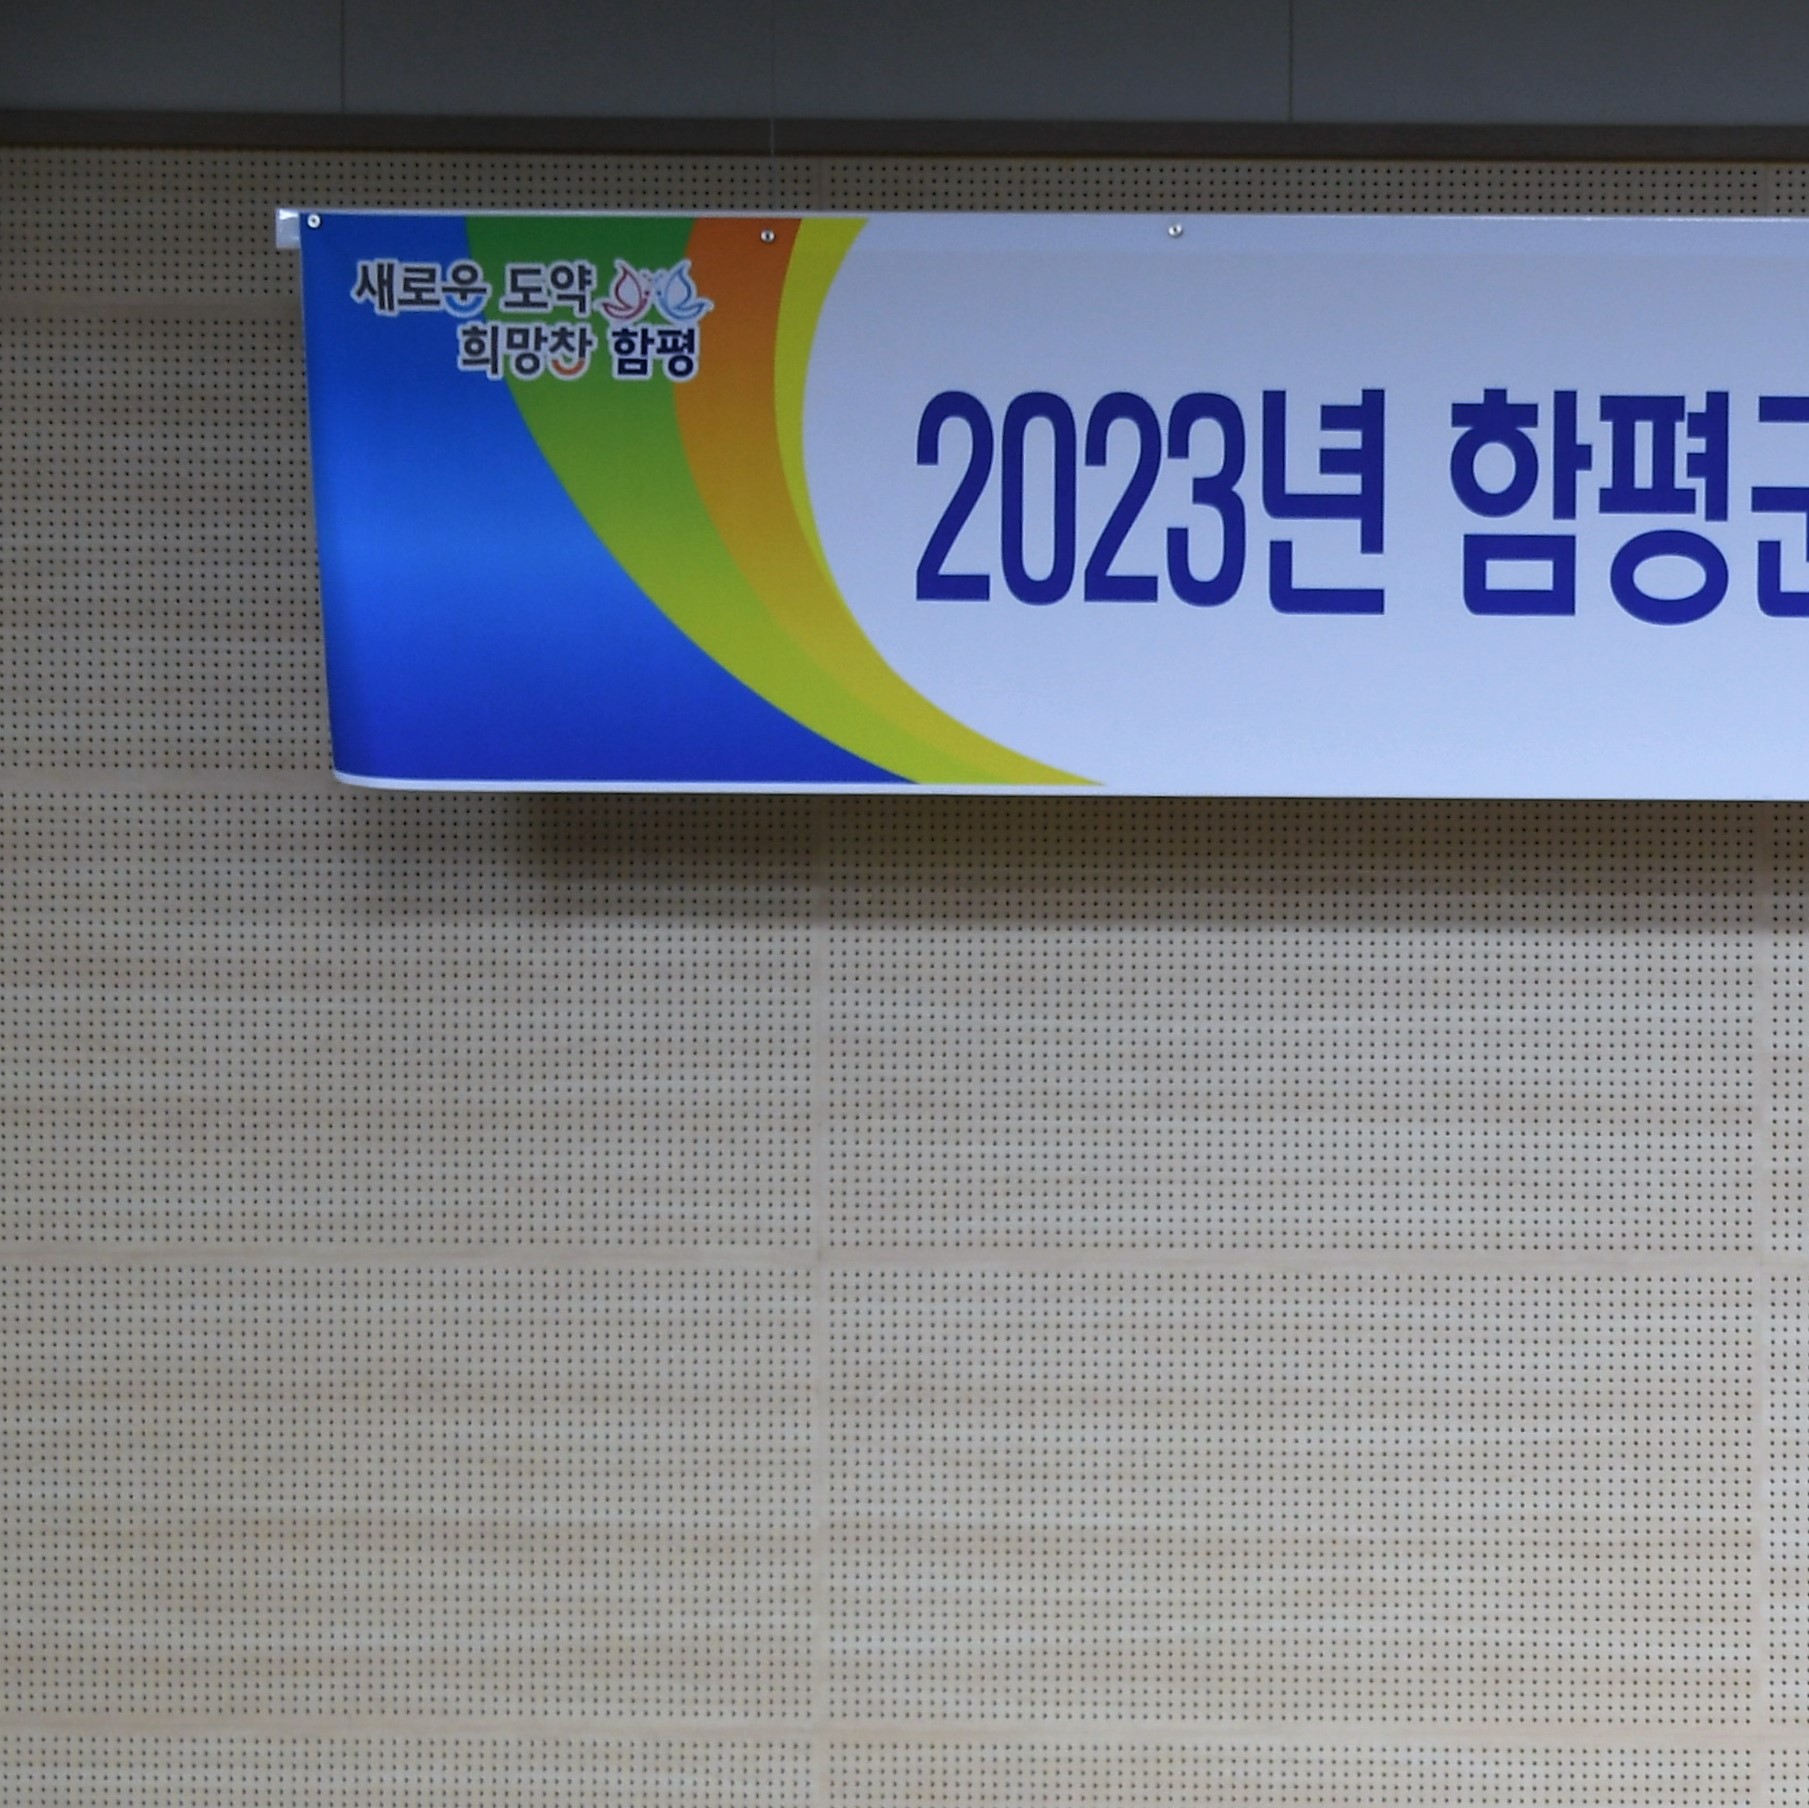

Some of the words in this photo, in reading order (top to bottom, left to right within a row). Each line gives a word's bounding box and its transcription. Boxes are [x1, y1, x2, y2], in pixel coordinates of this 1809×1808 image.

[353, 261, 489, 316] 새로운
[502, 262, 594, 315] 도약
[460, 324, 594, 377] 희망찬
[610, 326, 697, 379] 함평
[915, 386, 1387, 615] 2023년
